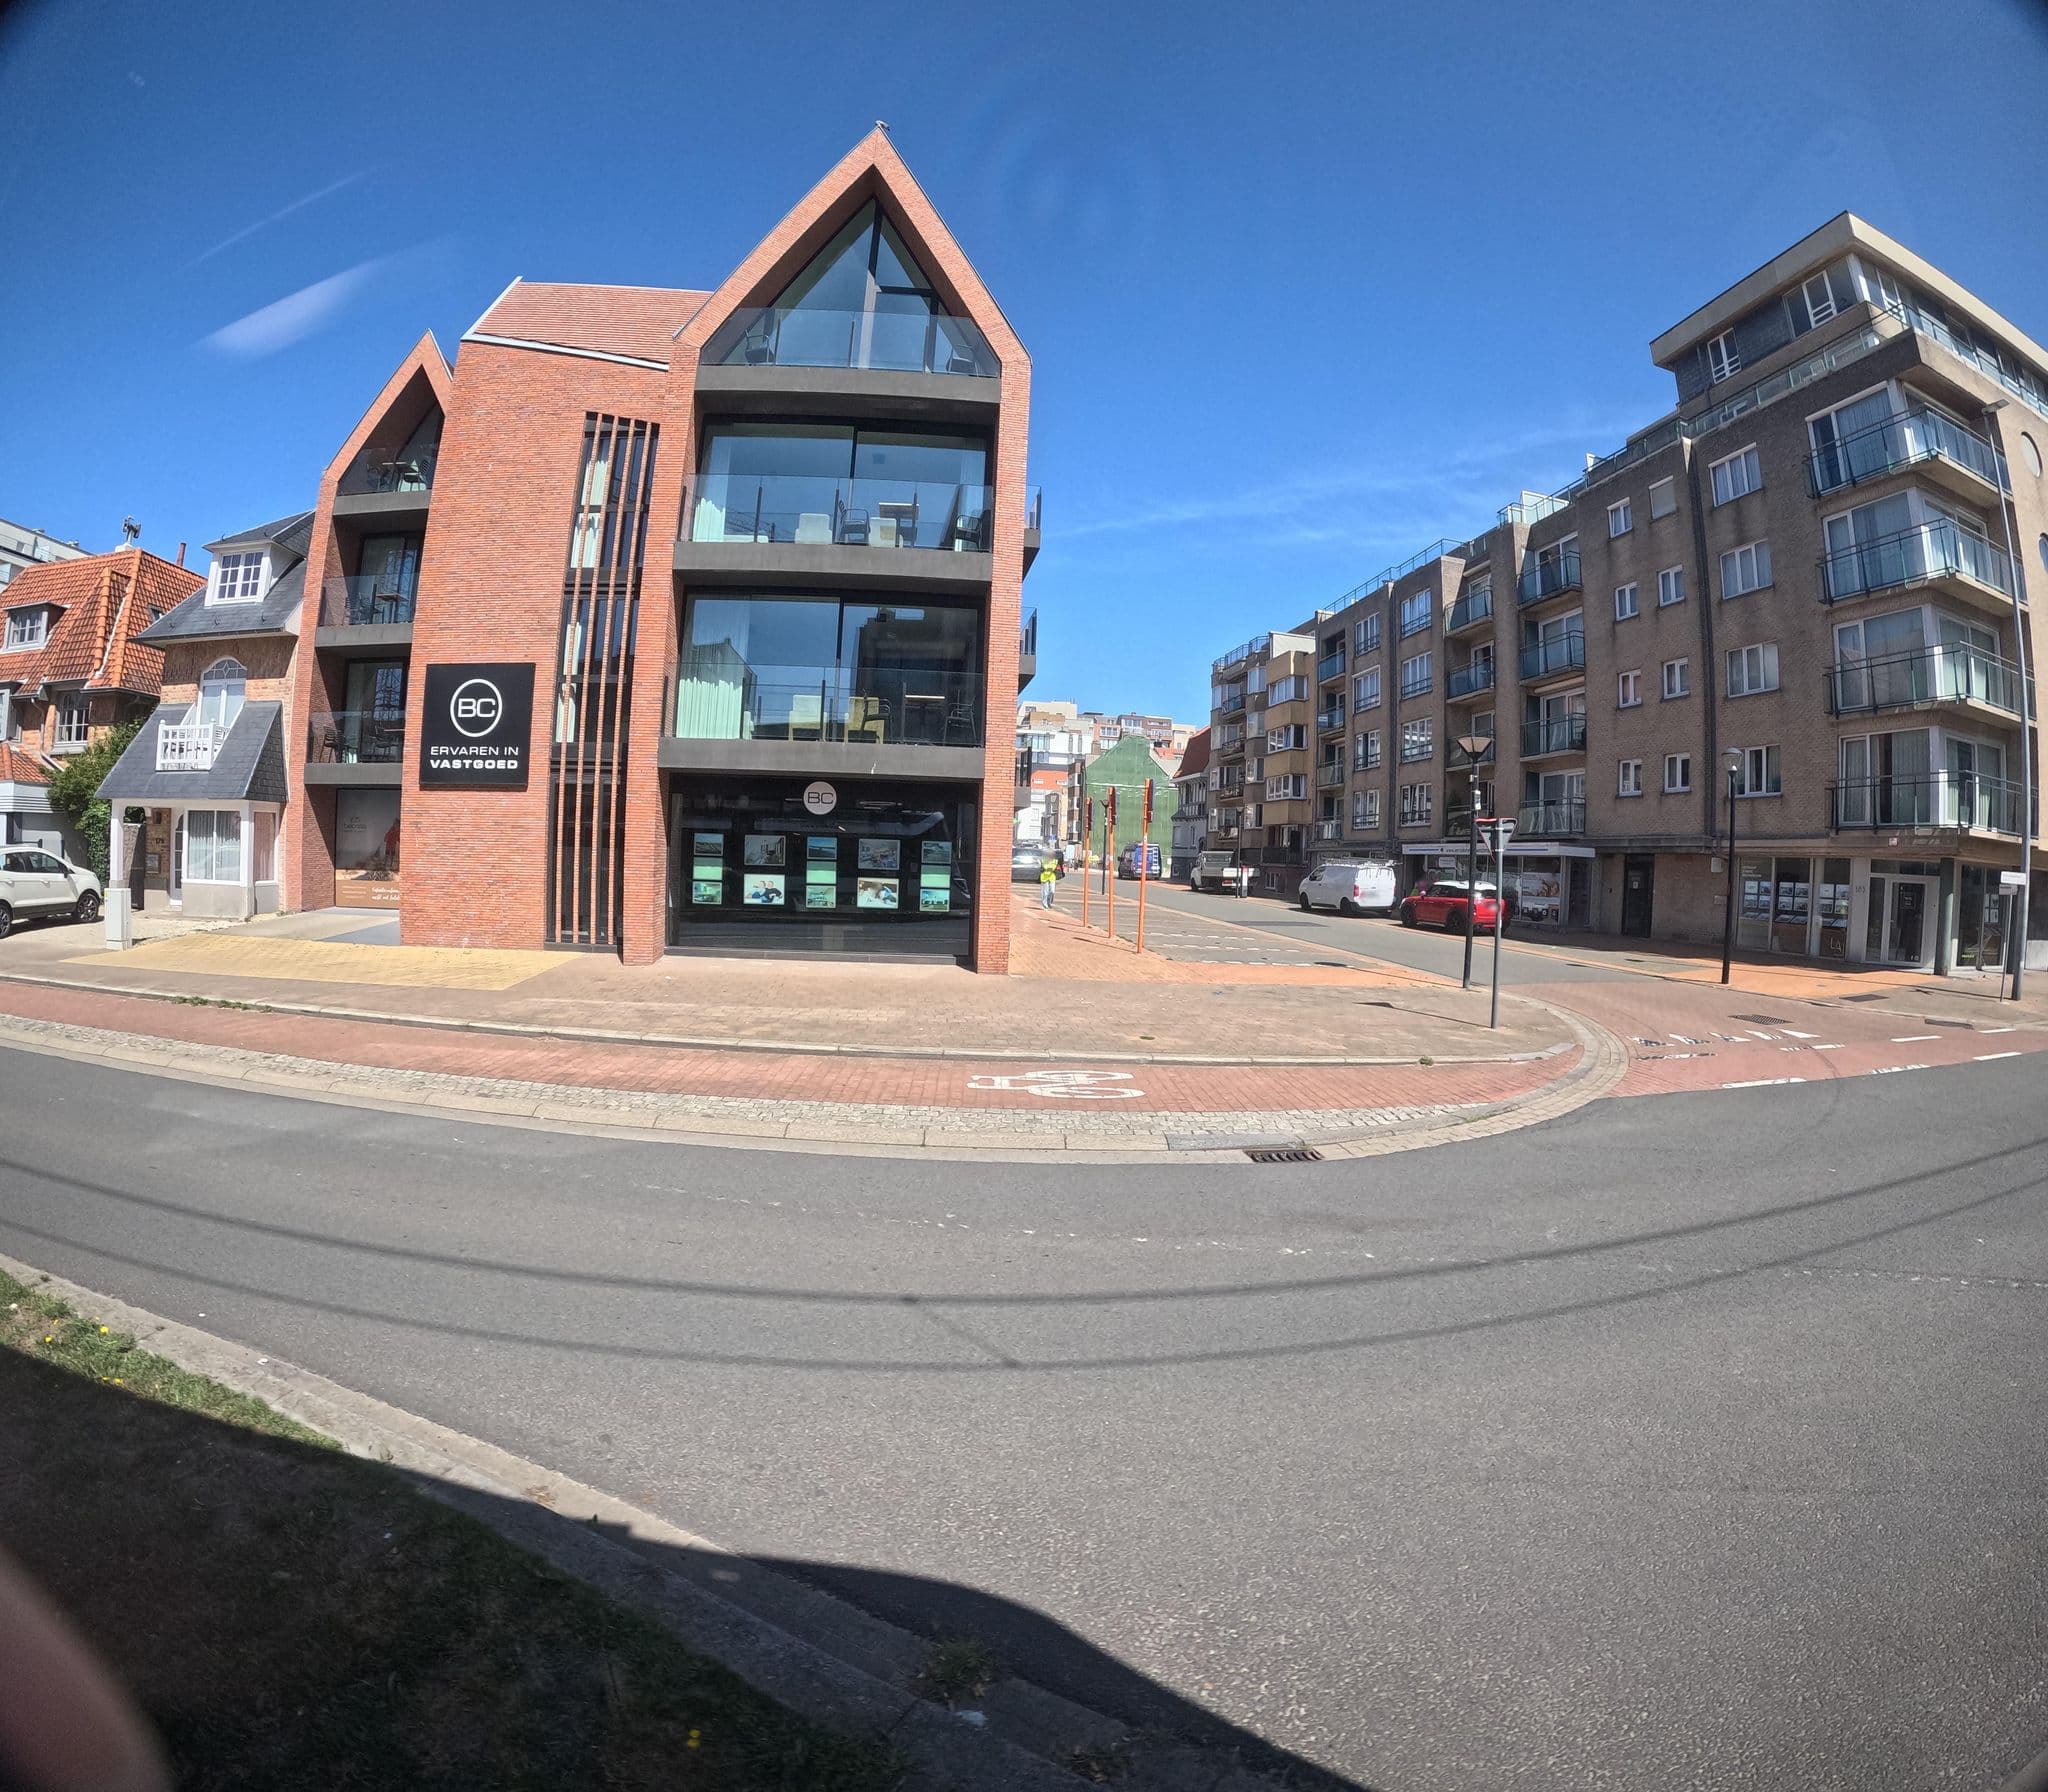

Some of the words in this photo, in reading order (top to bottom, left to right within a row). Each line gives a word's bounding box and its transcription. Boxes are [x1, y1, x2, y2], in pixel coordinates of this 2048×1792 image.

[457, 698, 496, 718] BC
[430, 746, 499, 756] ERVAREN
[504, 746, 519, 756] IN
[430, 759, 518, 769] VASTGOED
[808, 791, 834, 804] BC
